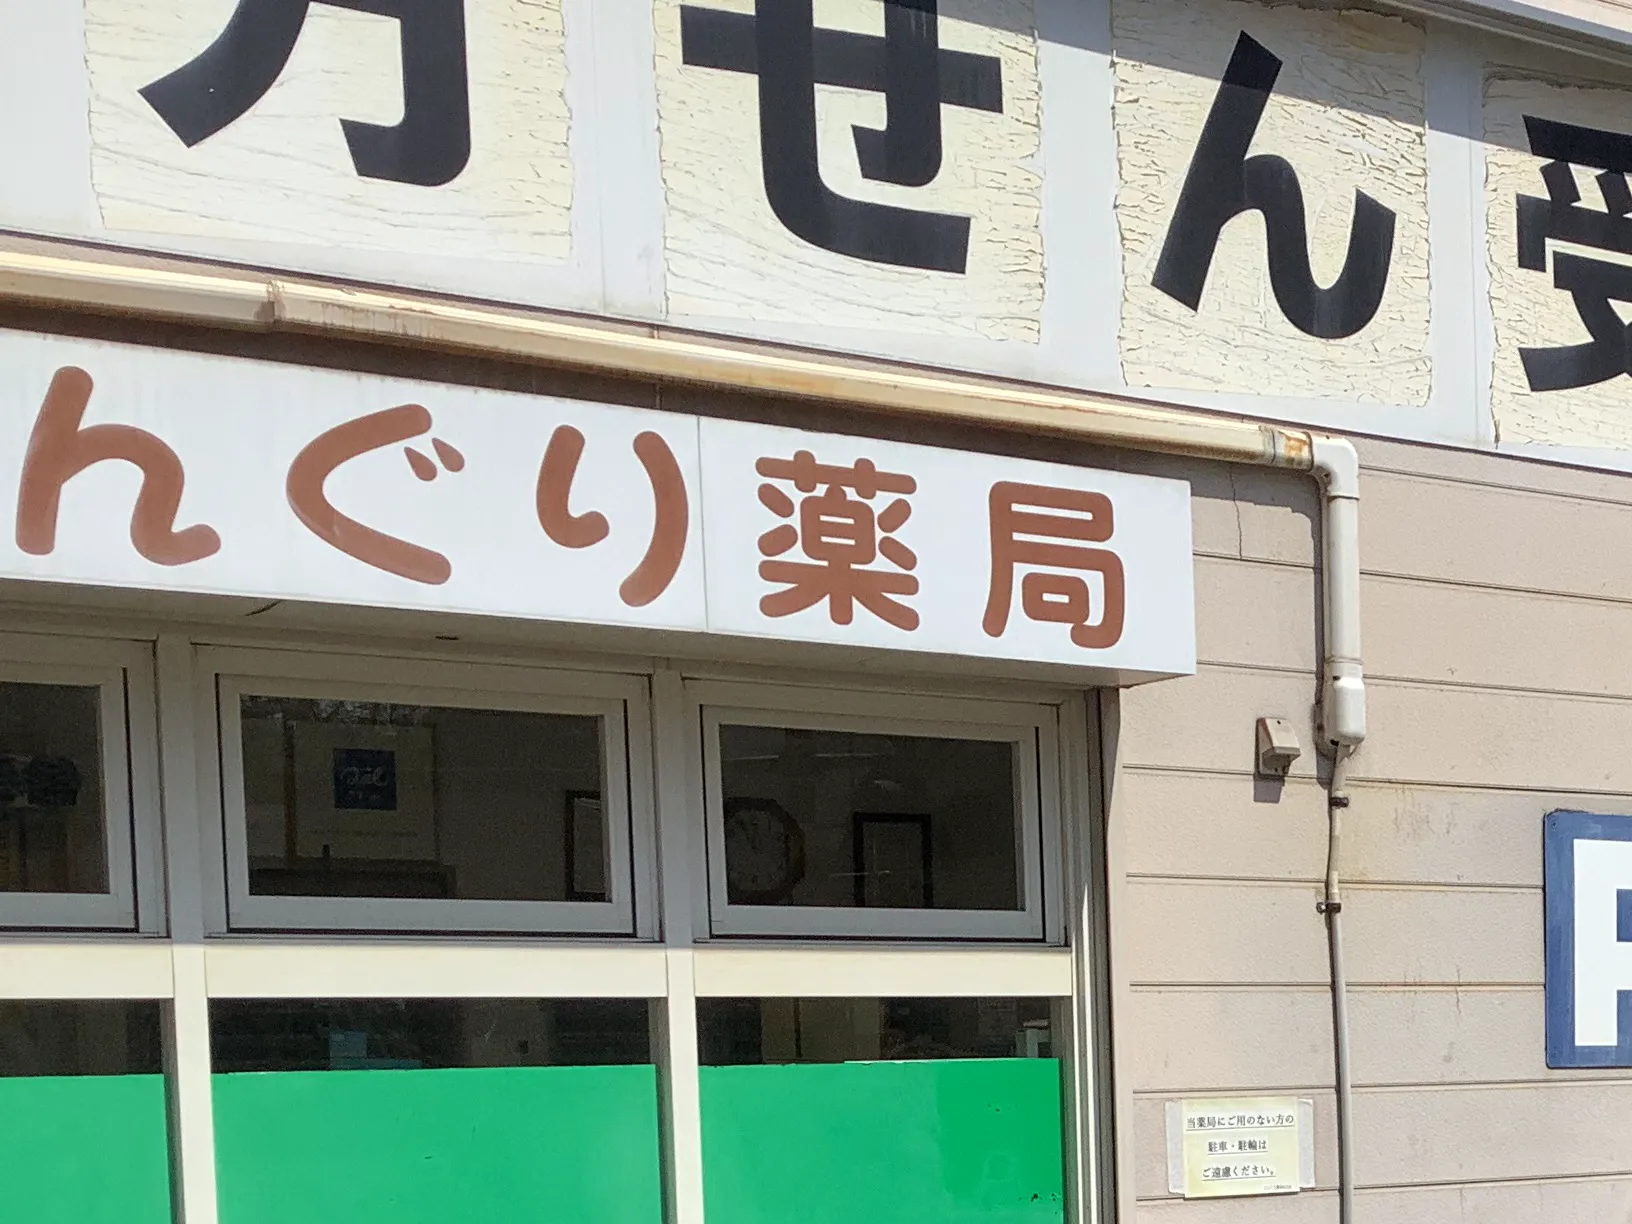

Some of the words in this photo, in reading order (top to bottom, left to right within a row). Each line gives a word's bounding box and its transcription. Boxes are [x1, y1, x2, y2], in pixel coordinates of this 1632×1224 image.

[14, 364, 1128, 651] んぐり薬局
[1186, 1113, 1295, 1130] 当薬局にご用のない方の
[1207, 1139, 1268, 1153] 駐車・駐輪は
[1202, 1165, 1275, 1179] ご遠慮ください。
